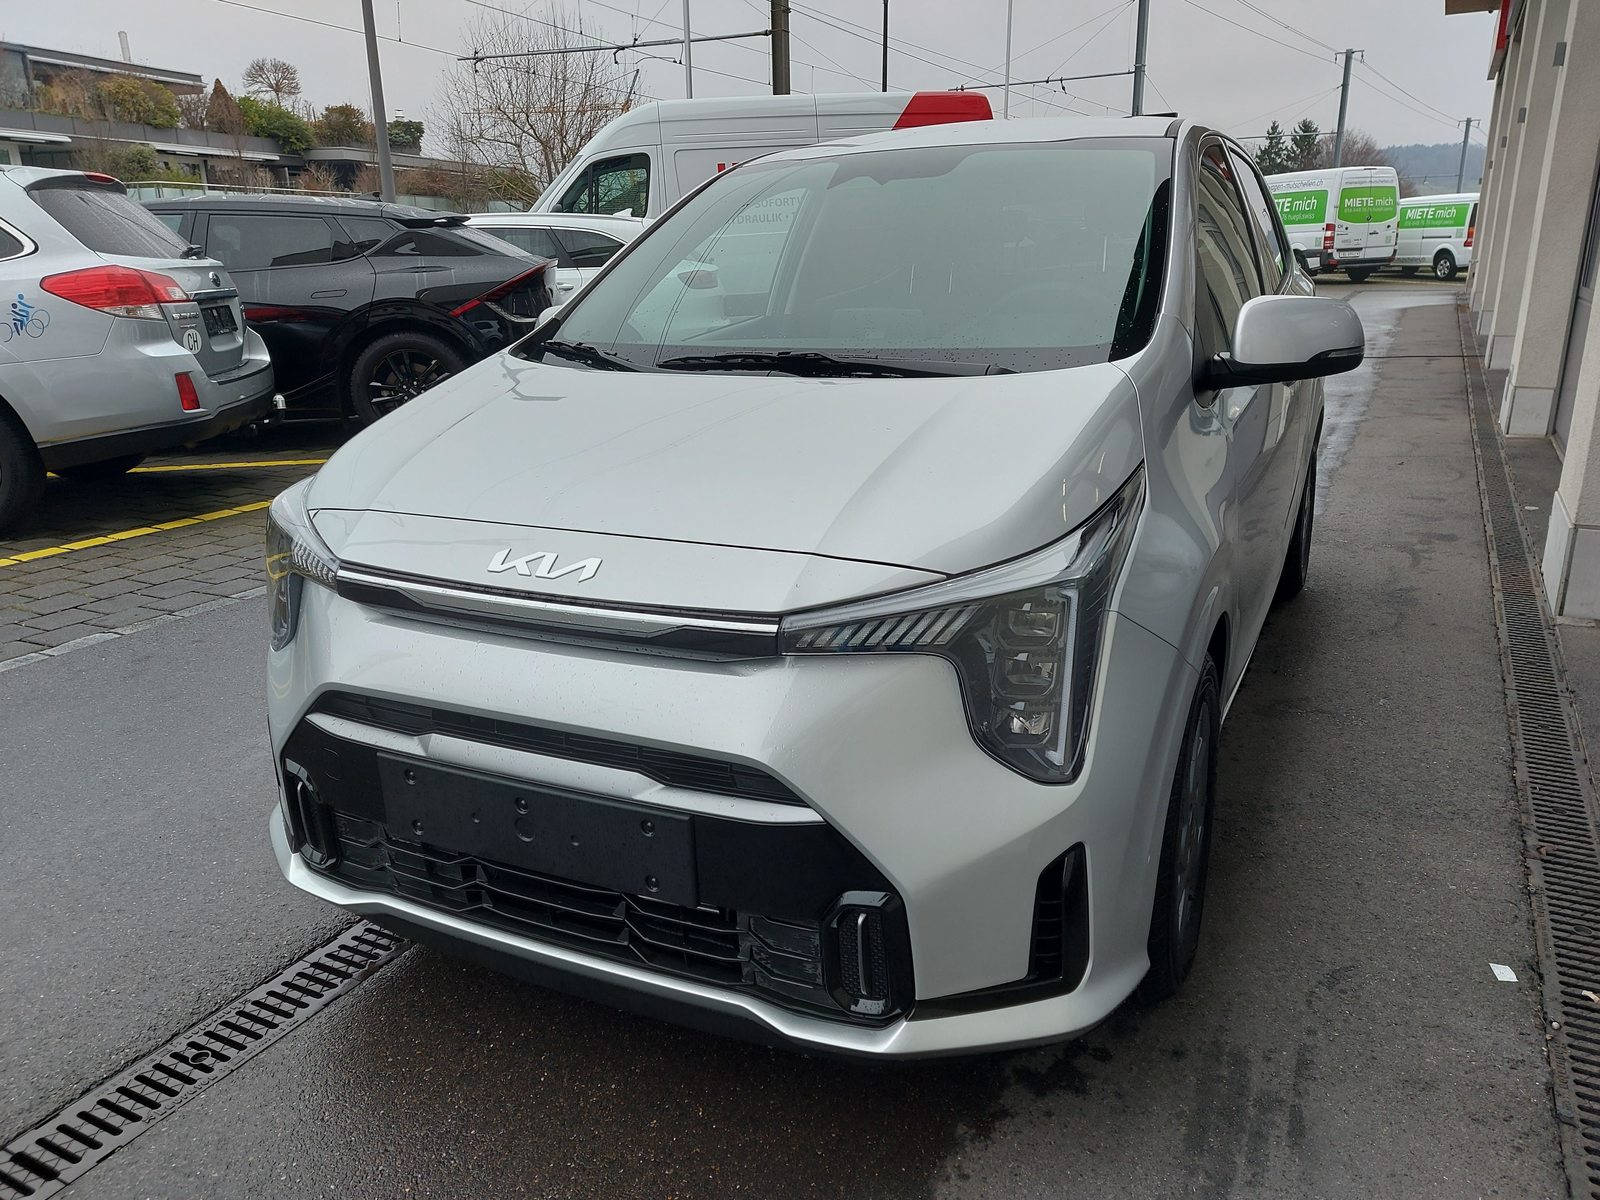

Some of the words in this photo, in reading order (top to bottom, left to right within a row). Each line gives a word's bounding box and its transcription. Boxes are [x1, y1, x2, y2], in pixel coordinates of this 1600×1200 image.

[1292, 195, 1317, 211] mich
[1344, 197, 1374, 208] MIETE
[1375, 197, 1394, 207] mich
[1406, 207, 1435, 220] MIETE
[1435, 205, 1457, 218] mich
[187, 332, 199, 351] CH
[487, 547, 603, 583] KIA
